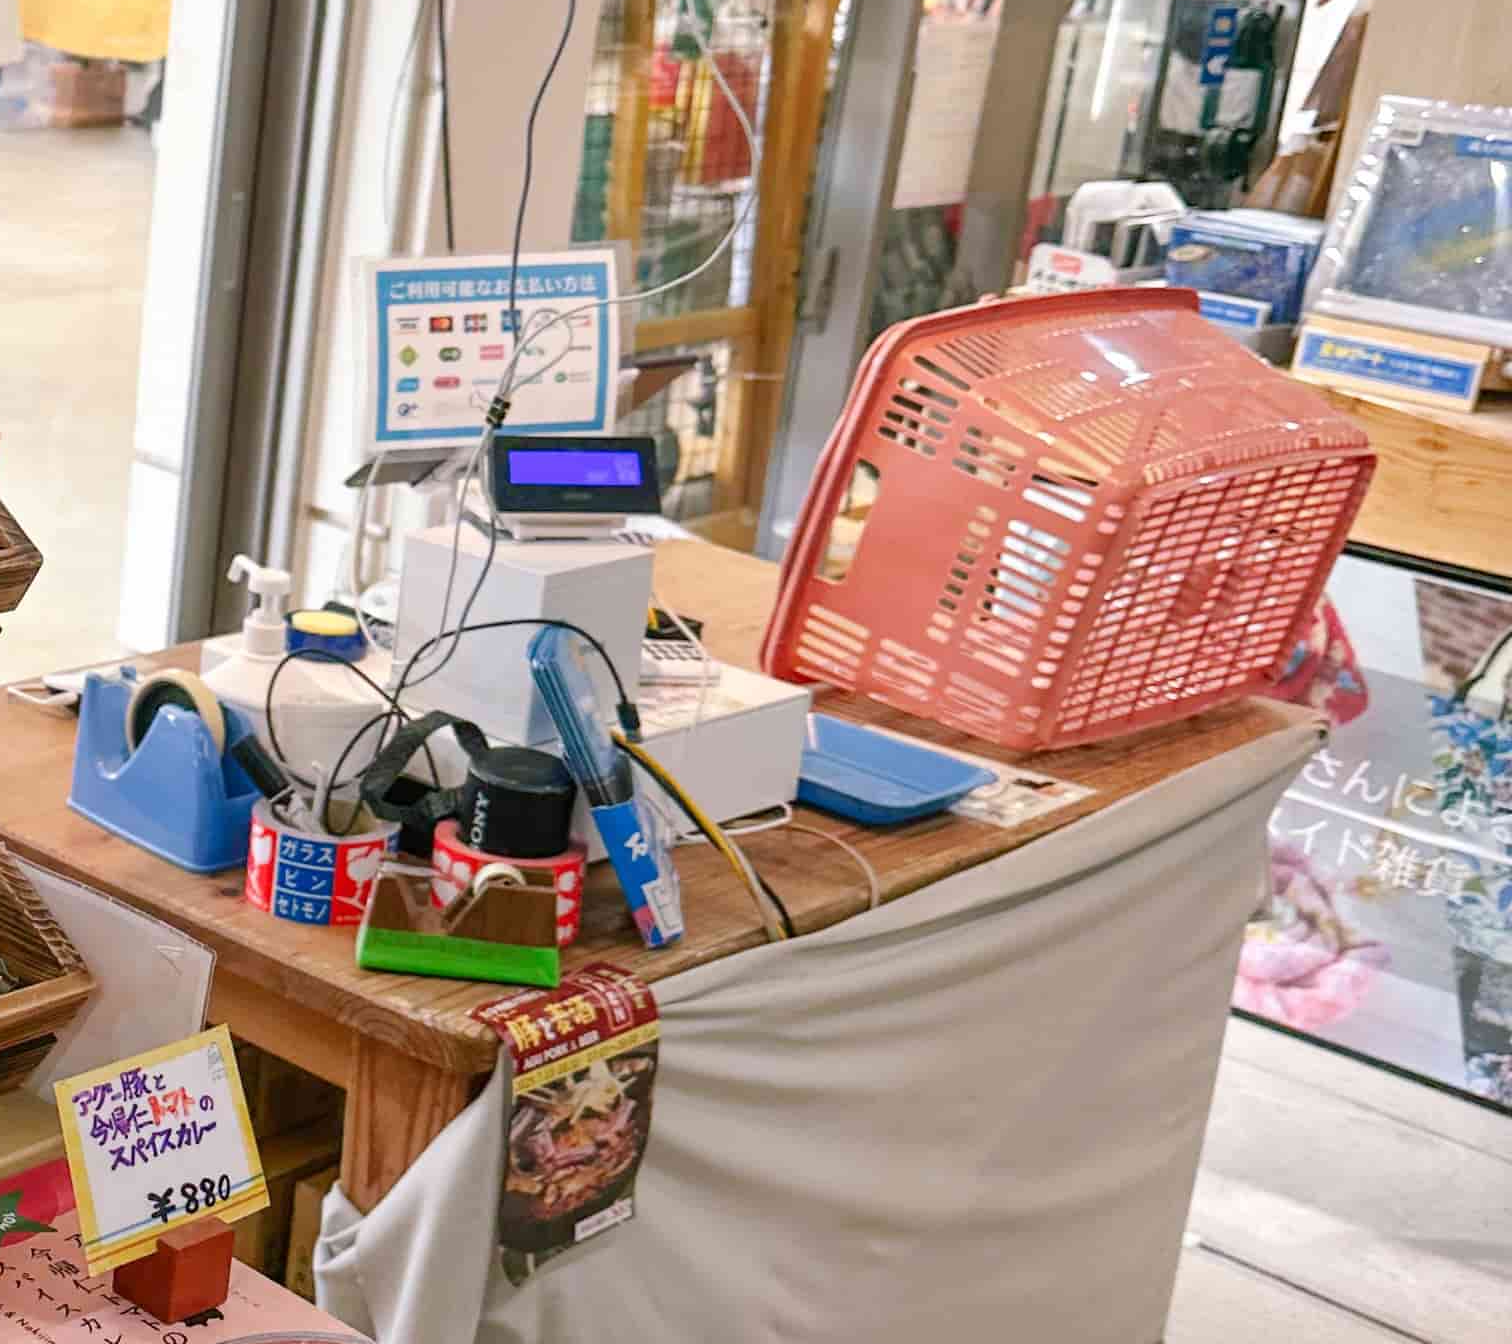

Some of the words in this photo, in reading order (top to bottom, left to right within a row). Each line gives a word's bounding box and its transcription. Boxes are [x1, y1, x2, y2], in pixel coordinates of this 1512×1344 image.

[390, 275, 597, 300] ご利用可能なお支払い方法
[280, 838, 335, 866] ガラス
[276, 895, 330, 922] セトモノ
[71, 1067, 168, 1118] アグー豚と
[89, 1086, 215, 1146] 今帰仁トマトの
[109, 1121, 218, 1171] スパイスカレー
[147, 1173, 232, 1224] ¥880
